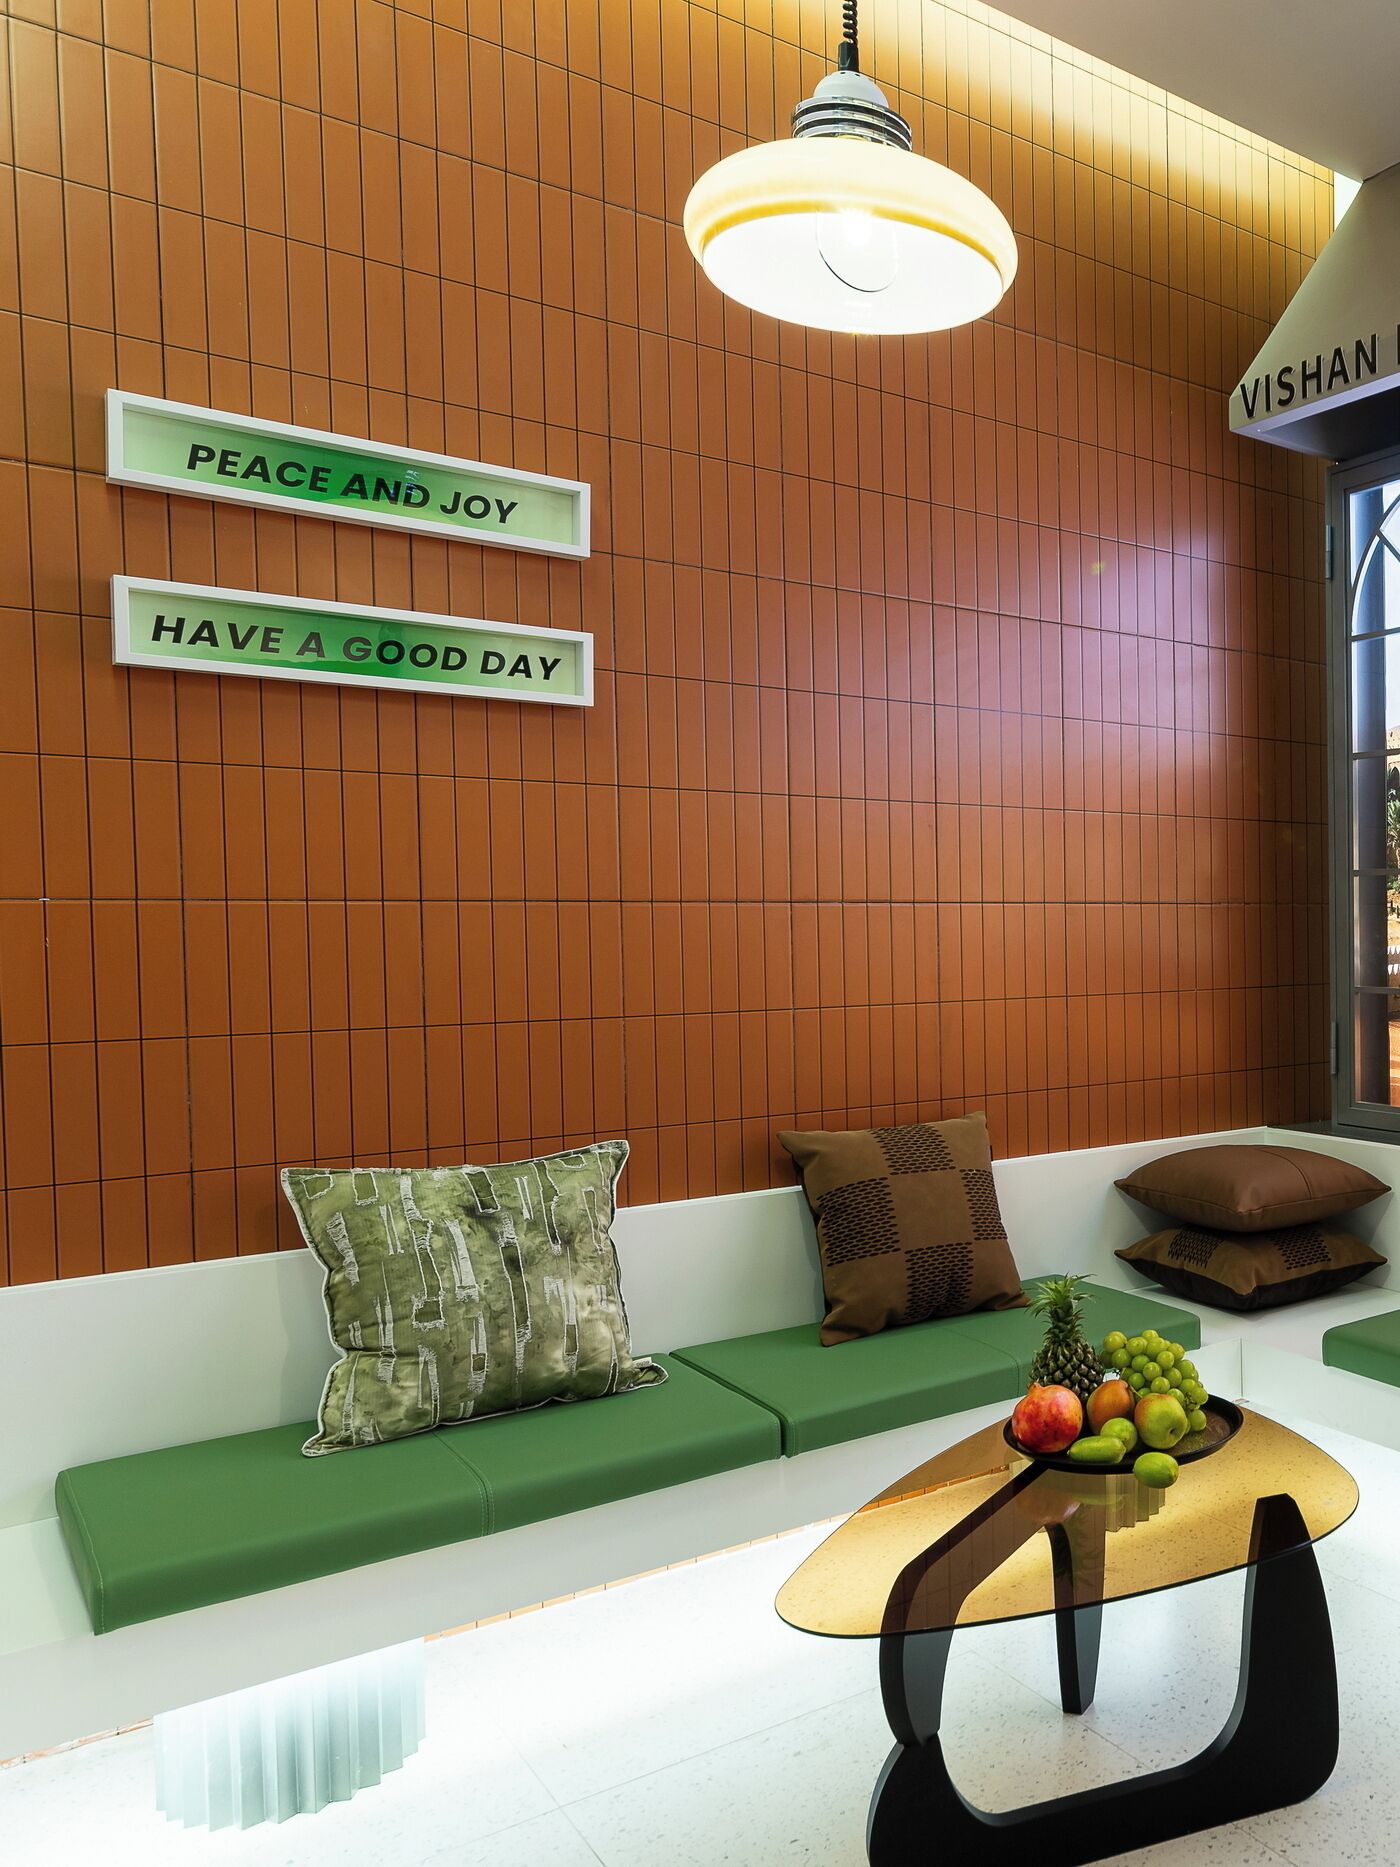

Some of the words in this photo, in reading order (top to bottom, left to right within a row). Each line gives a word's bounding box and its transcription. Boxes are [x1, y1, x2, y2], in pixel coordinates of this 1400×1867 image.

[1240, 333, 1378, 418] VISHAN
[186, 443, 331, 494] PEACE
[339, 472, 431, 508] AND
[440, 492, 518, 524] JOY
[151, 614, 283, 654] HAVE
[296, 631, 326, 659] A
[342, 638, 467, 671] GOOD
[480, 650, 562, 681] DAY
